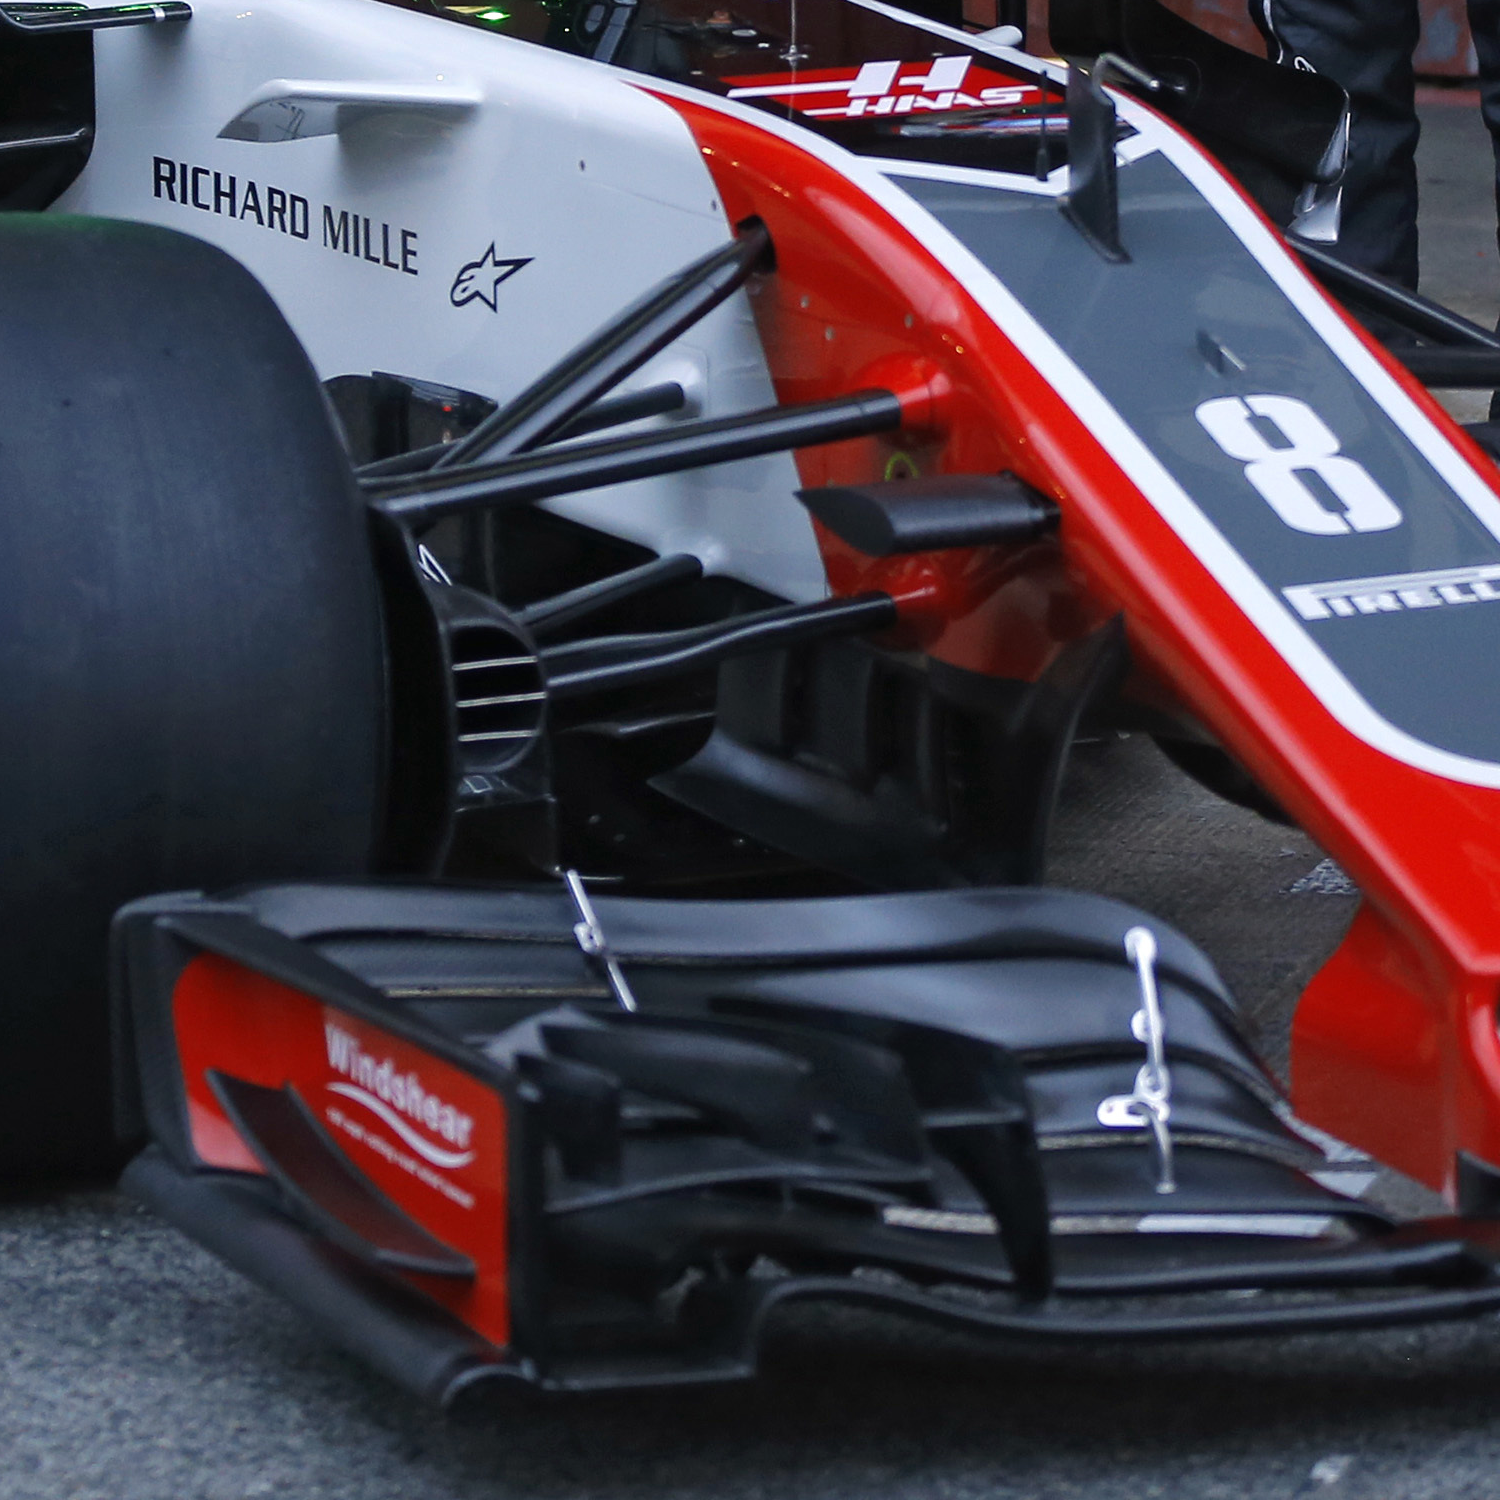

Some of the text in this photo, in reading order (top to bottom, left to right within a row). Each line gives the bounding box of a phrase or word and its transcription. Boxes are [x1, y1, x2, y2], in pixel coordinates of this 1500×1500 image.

[802, 84, 1039, 117] HAAS
[152, 155, 419, 276] RICHARD MILLE
[1195, 393, 1403, 536] 8
